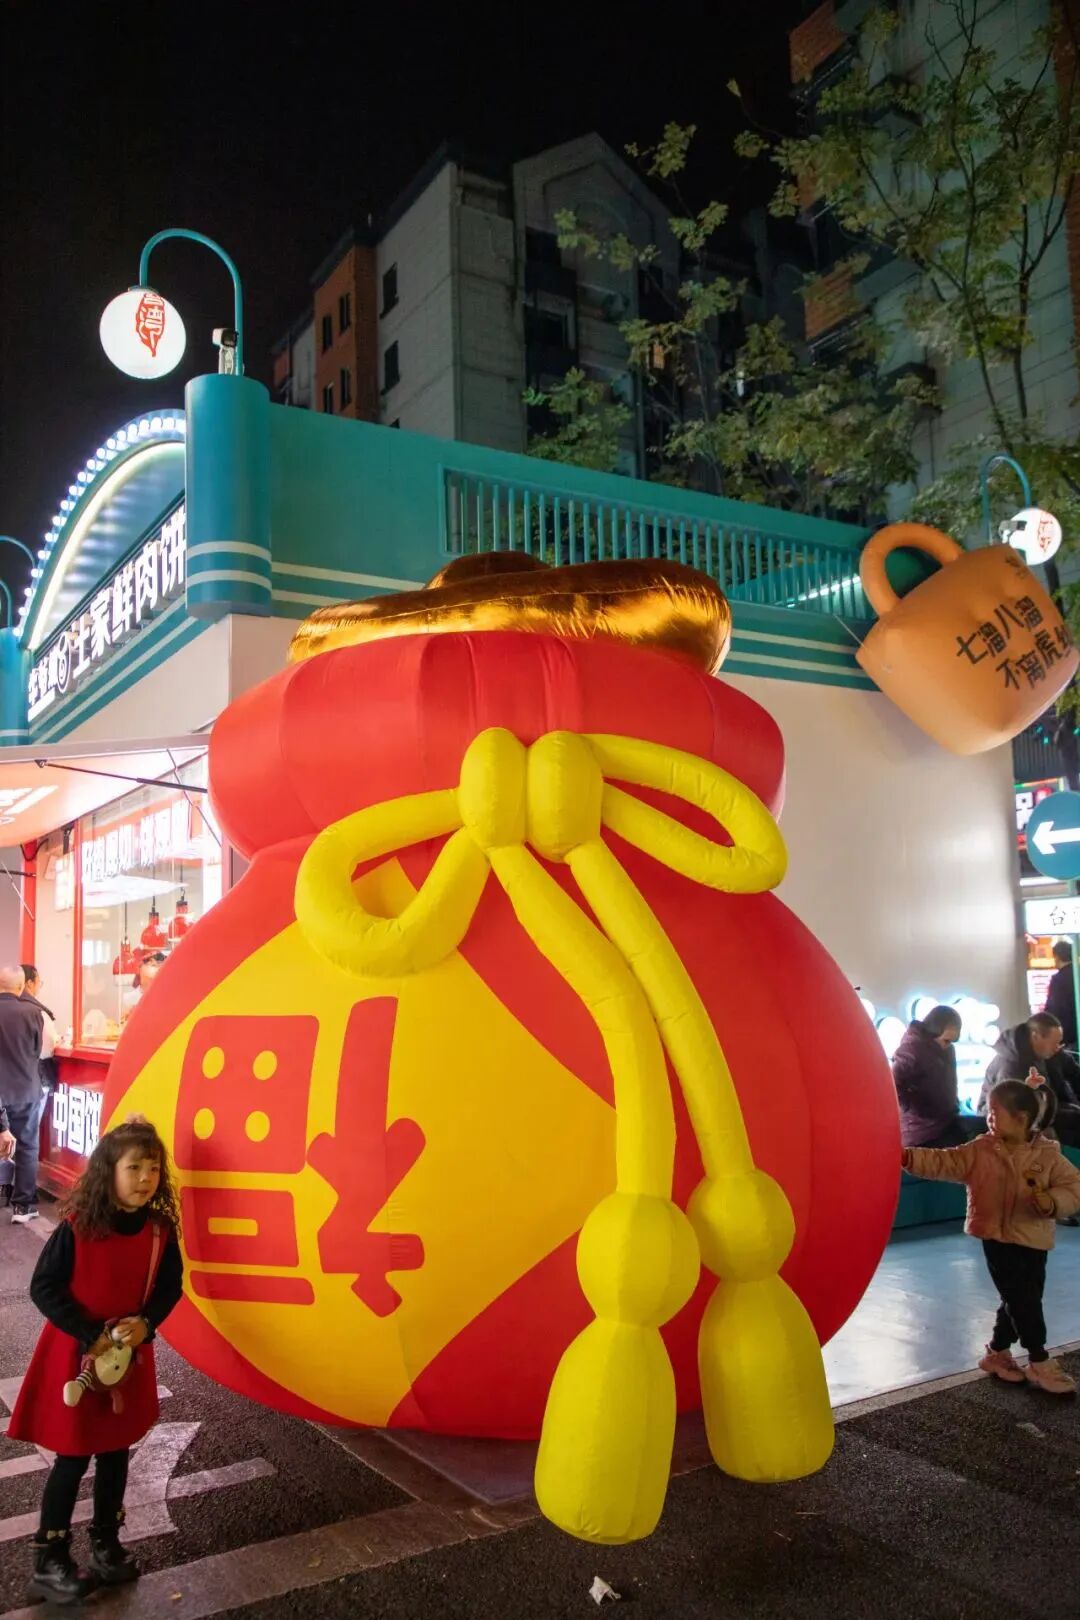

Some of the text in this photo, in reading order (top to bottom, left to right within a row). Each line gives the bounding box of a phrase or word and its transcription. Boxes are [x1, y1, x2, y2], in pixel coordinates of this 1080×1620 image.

[72, 503, 186, 679] 土家鲜肉饼
[174, 996, 426, 1317] 福
